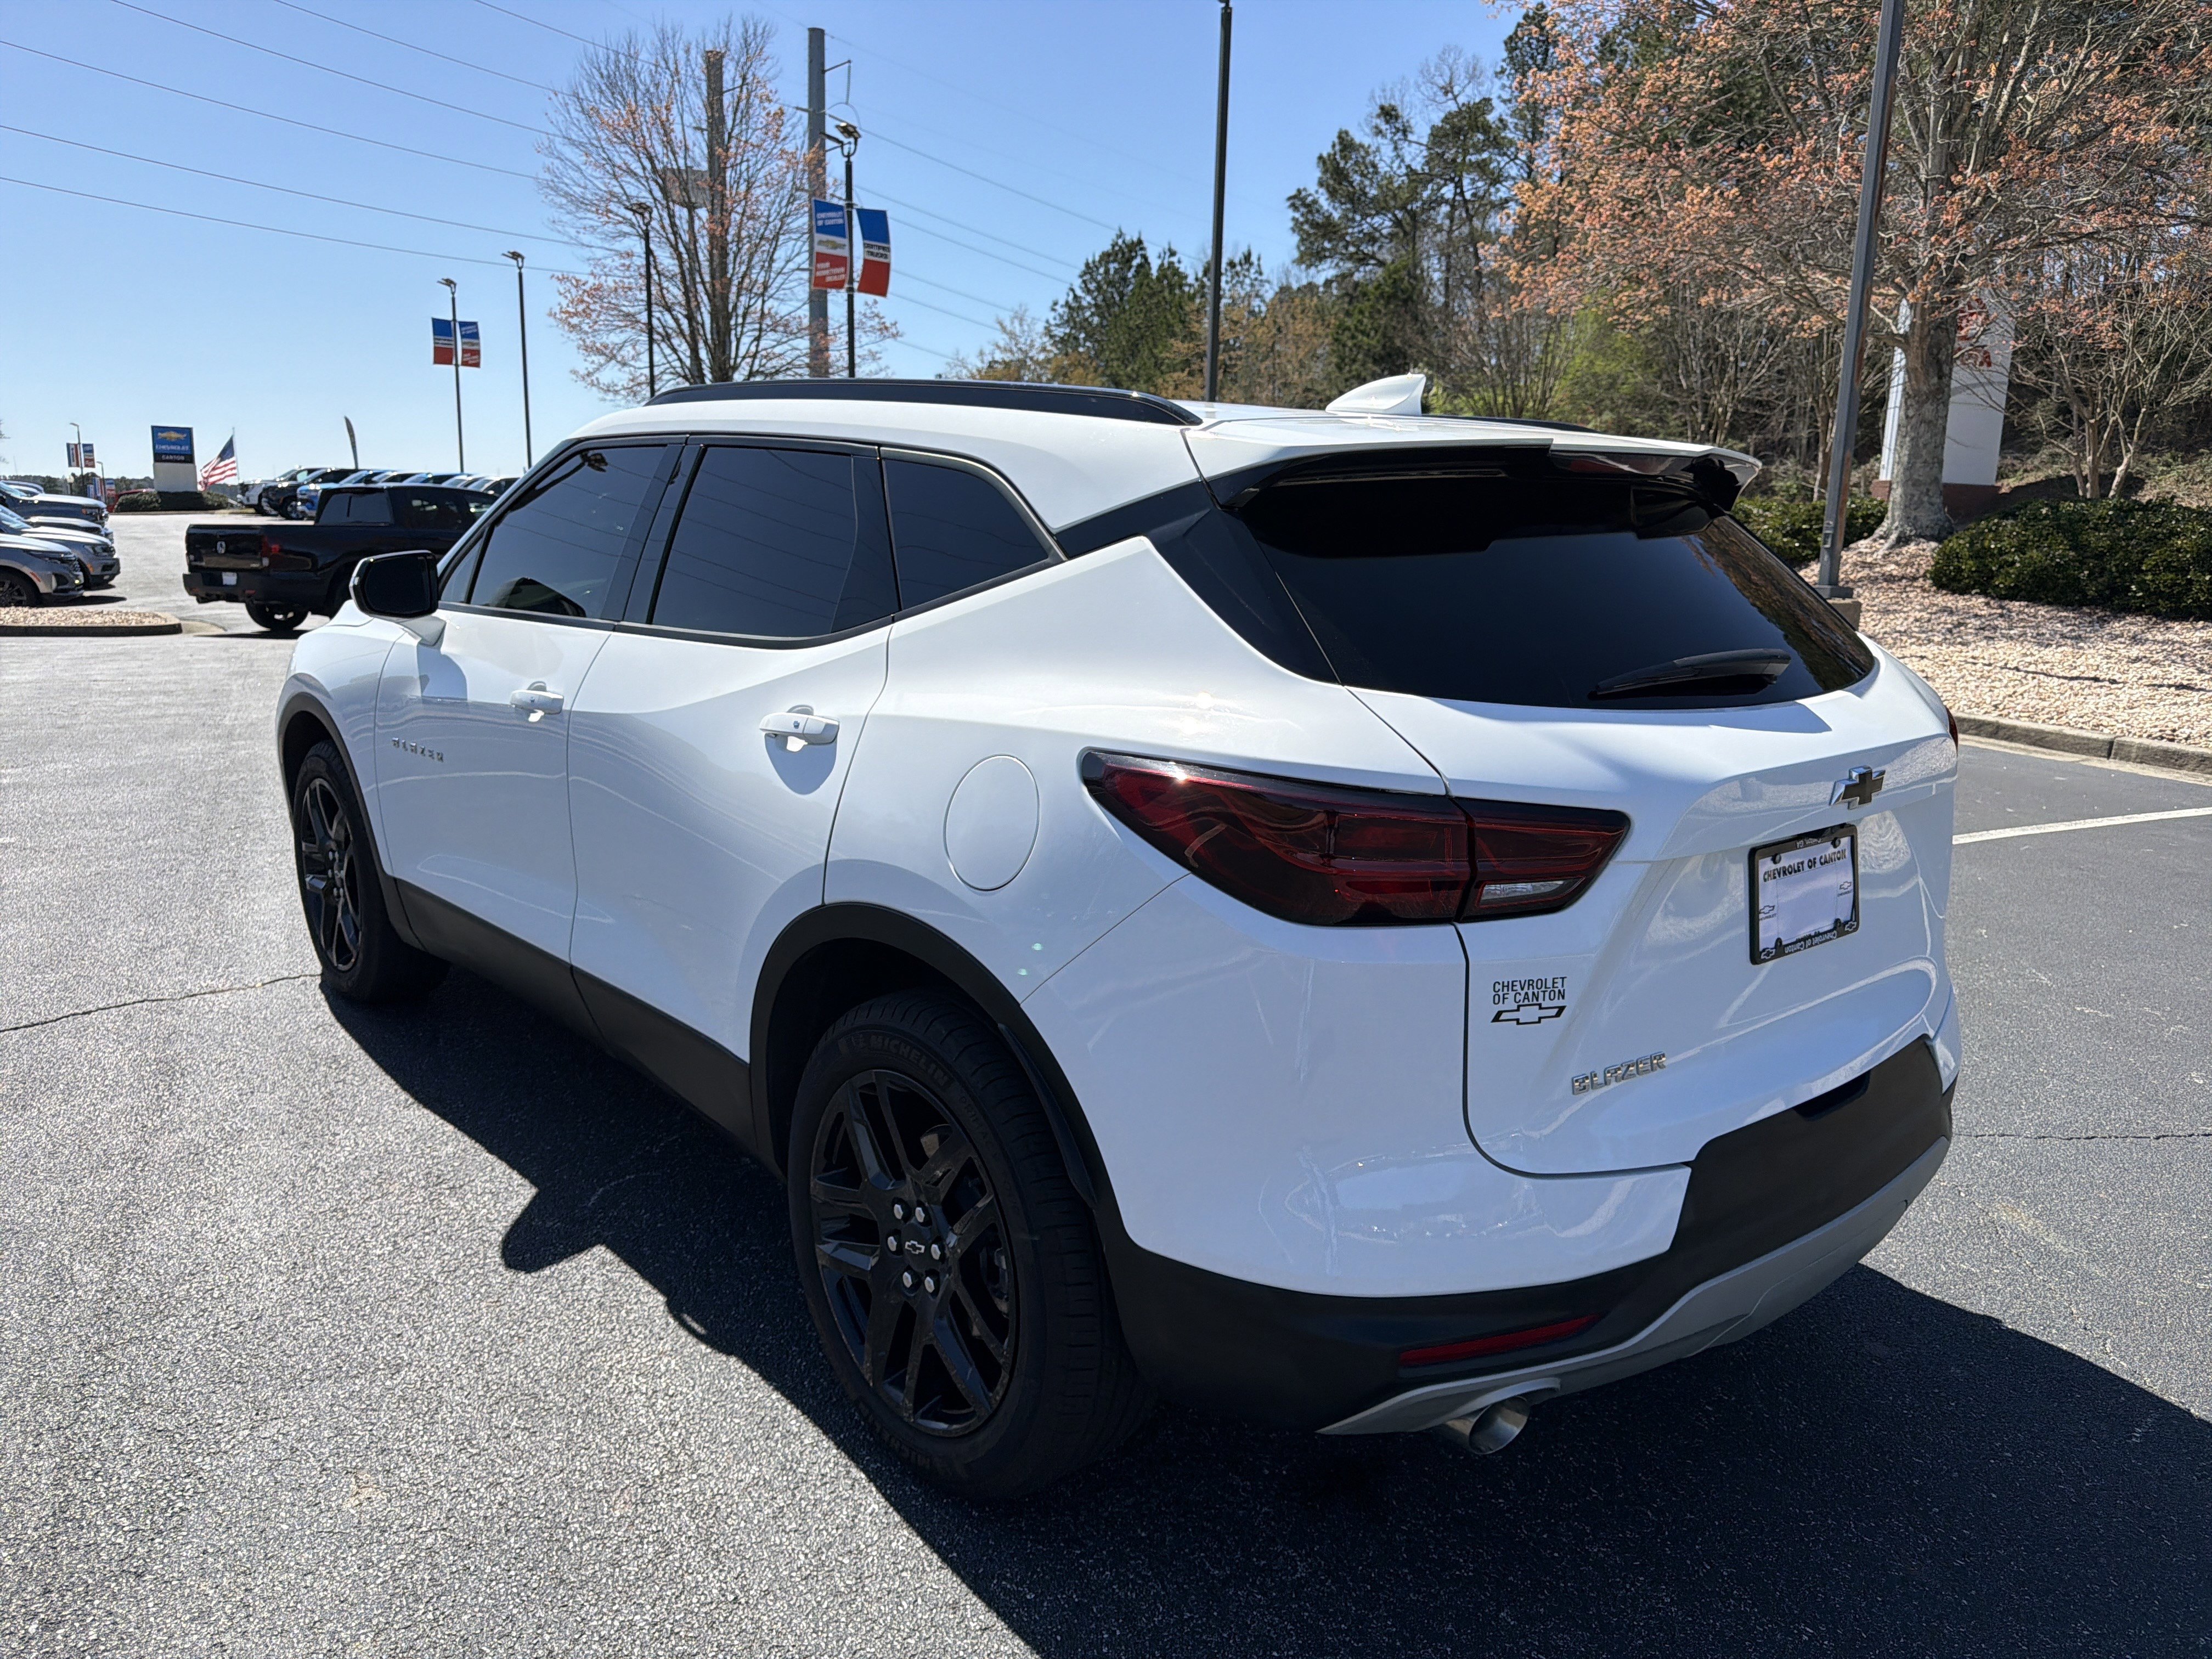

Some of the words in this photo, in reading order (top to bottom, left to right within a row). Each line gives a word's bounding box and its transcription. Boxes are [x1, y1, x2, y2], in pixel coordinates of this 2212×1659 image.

[392, 737, 444, 763] BLAZER
[1763, 860, 1805, 883] CHEVROLET
[1807, 857, 1817, 869] OF
[1819, 849, 1847, 866] CANTON
[1805, 938, 1812, 949] of
[1812, 930, 1838, 946] Chevrolet
[1784, 941, 1805, 953] Canton
[1493, 977, 1567, 993] CHEVROLET
[1493, 993, 1510, 1005] OF
[1514, 989, 1565, 1003] CANTON
[869, 1035, 950, 1086] MICHELIN
[1571, 1051, 1667, 1095] BLAZER
